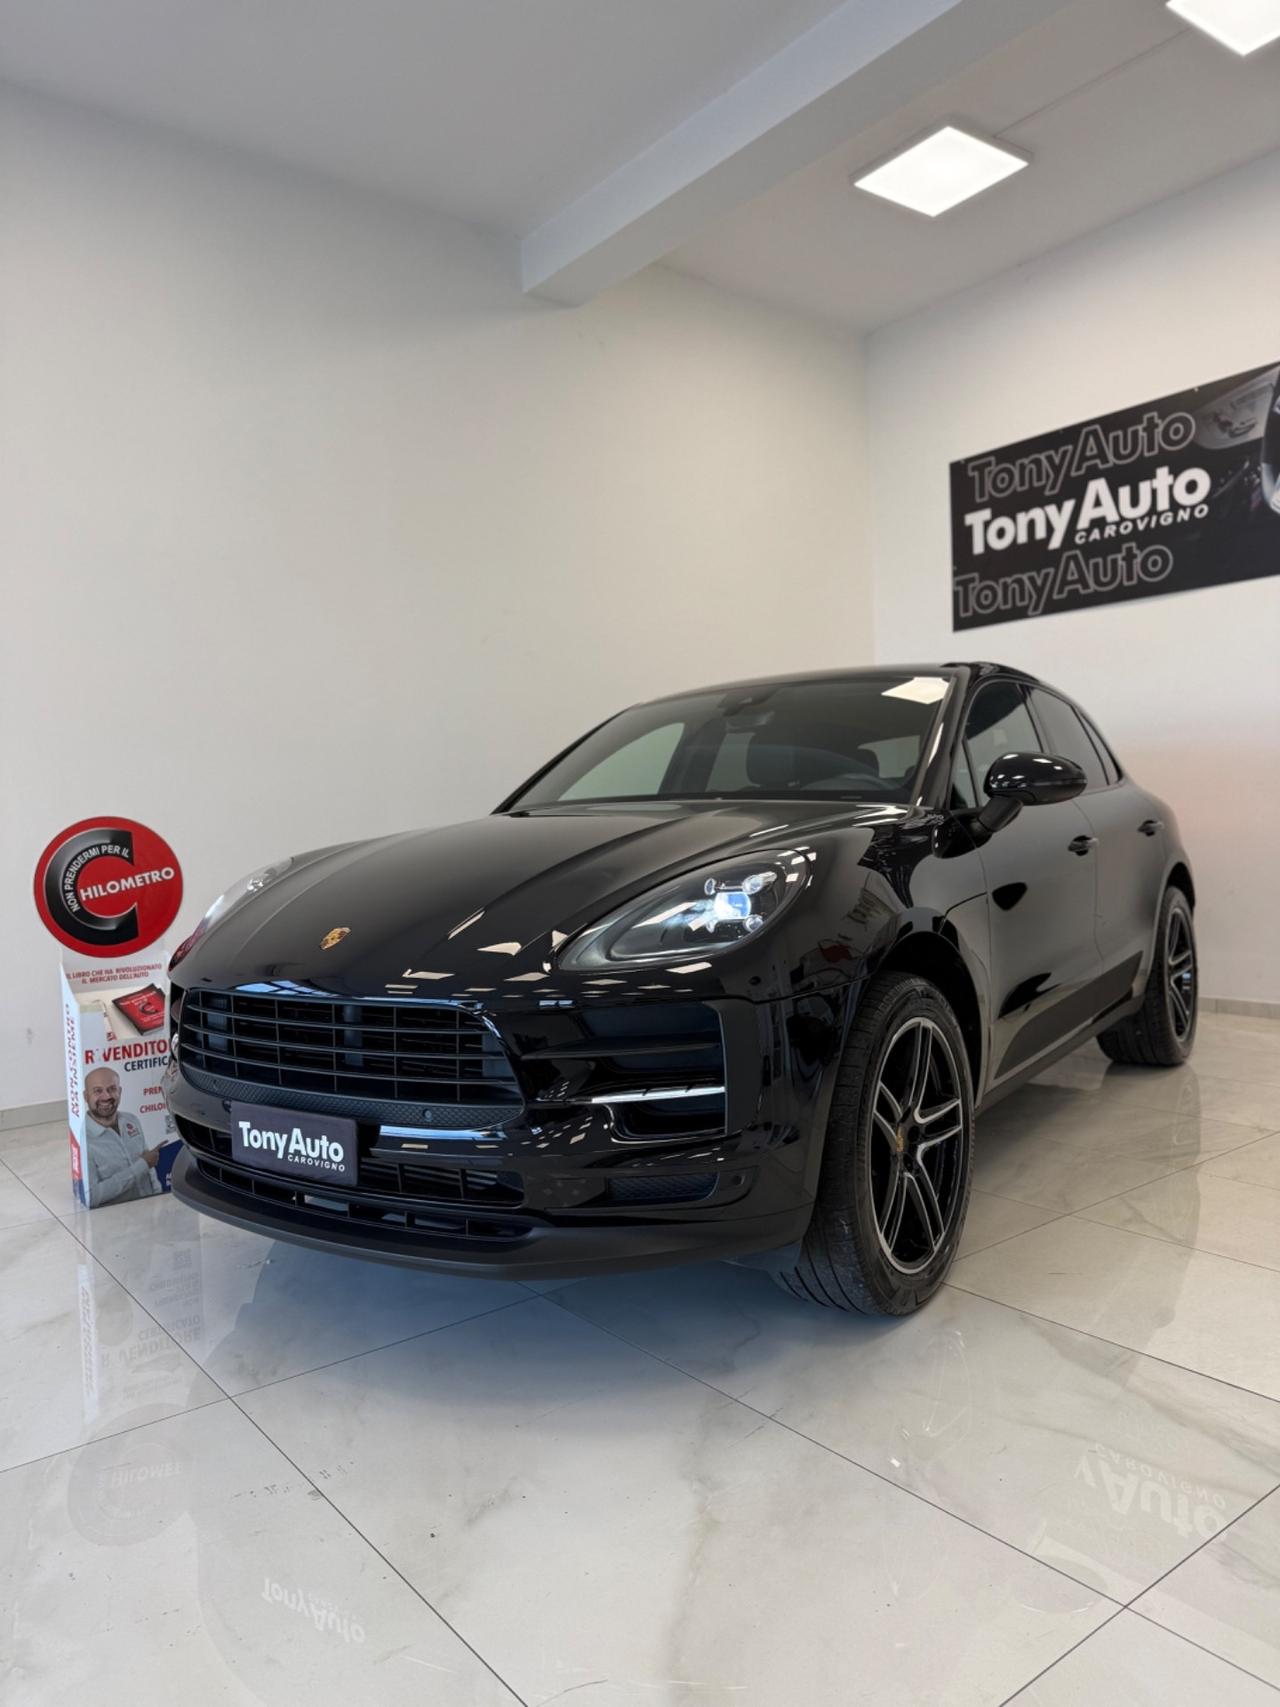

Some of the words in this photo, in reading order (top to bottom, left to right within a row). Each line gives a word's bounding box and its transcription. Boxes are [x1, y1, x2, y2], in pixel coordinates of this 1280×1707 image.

[1074, 504, 1210, 545] CAROVIGNO
[101, 844, 120, 856] PER
[121, 848, 130, 858] IL
[64, 846, 99, 891] PRENDERMI
[66, 892, 80, 913] NON
[72, 970, 91, 979] LIBRO
[91, 968, 103, 977] CHE
[89, 974, 118, 984] MERCATO
[124, 1055, 169, 1072] CERTIFIC
[287, 1154, 346, 1172] CAROVIGNO
